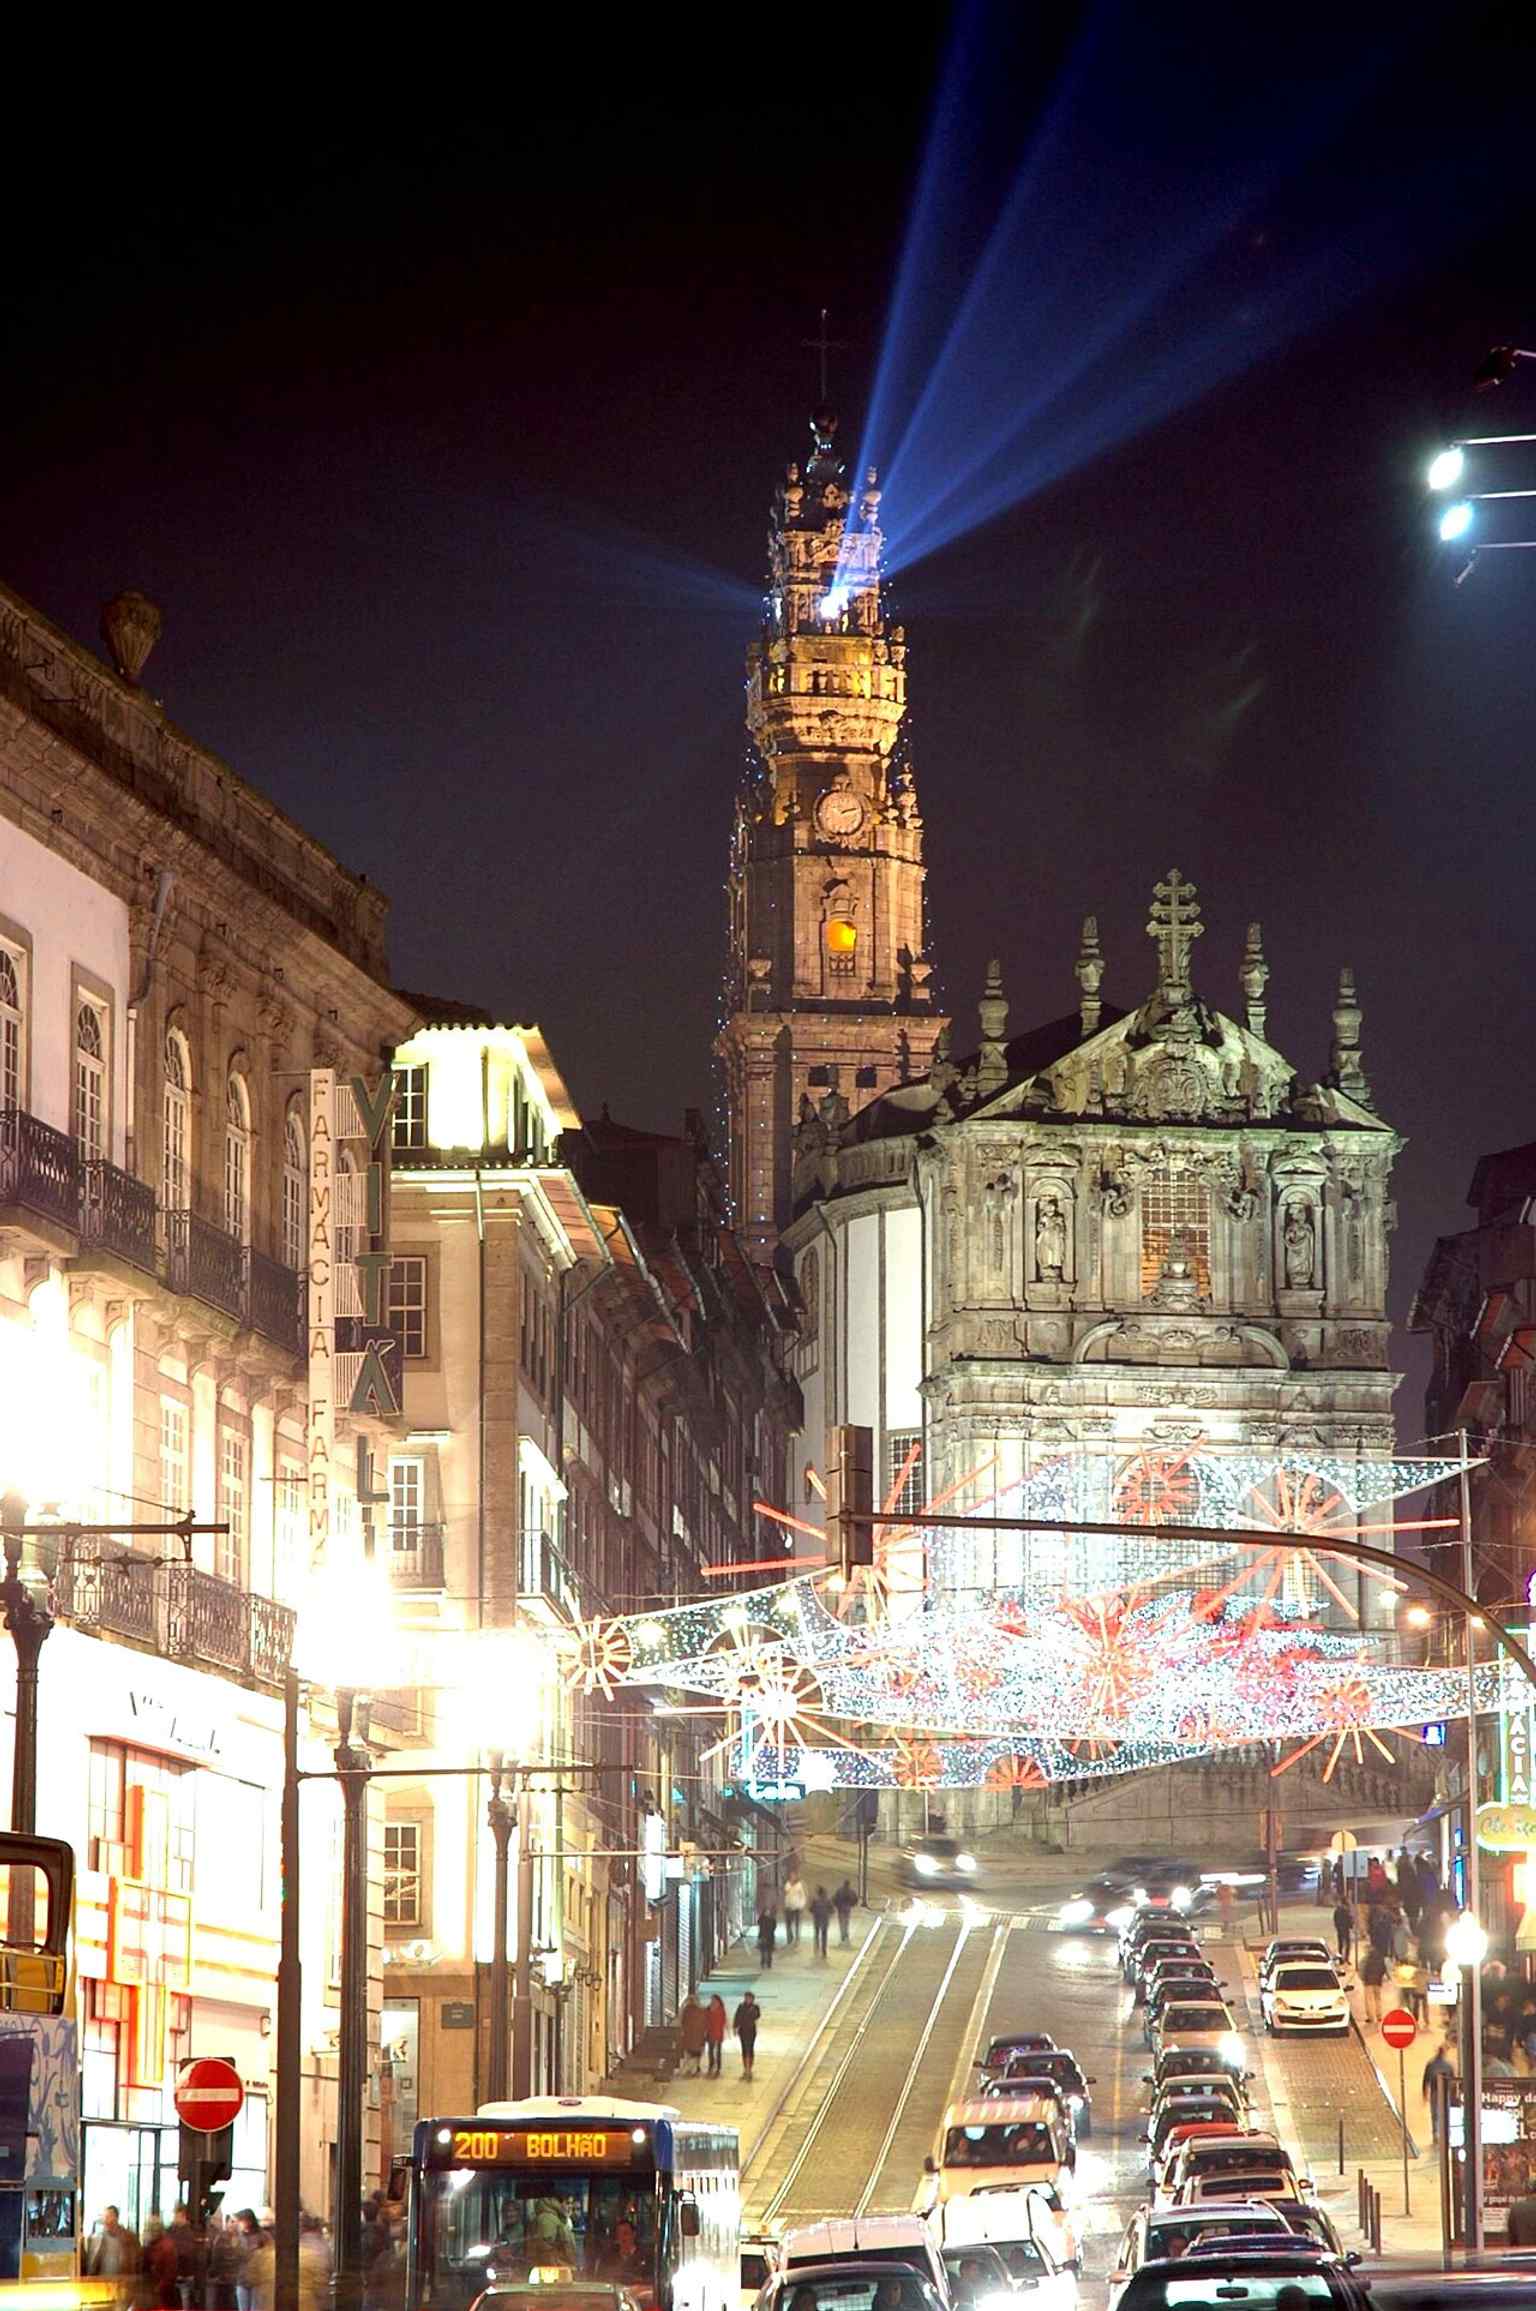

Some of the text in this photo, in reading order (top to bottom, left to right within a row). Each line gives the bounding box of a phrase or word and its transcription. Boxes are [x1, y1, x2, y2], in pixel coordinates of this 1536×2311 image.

[309, 1078, 332, 1360] FARMÁCIA
[454, 2132, 606, 2160] 200 BOLHÃO
